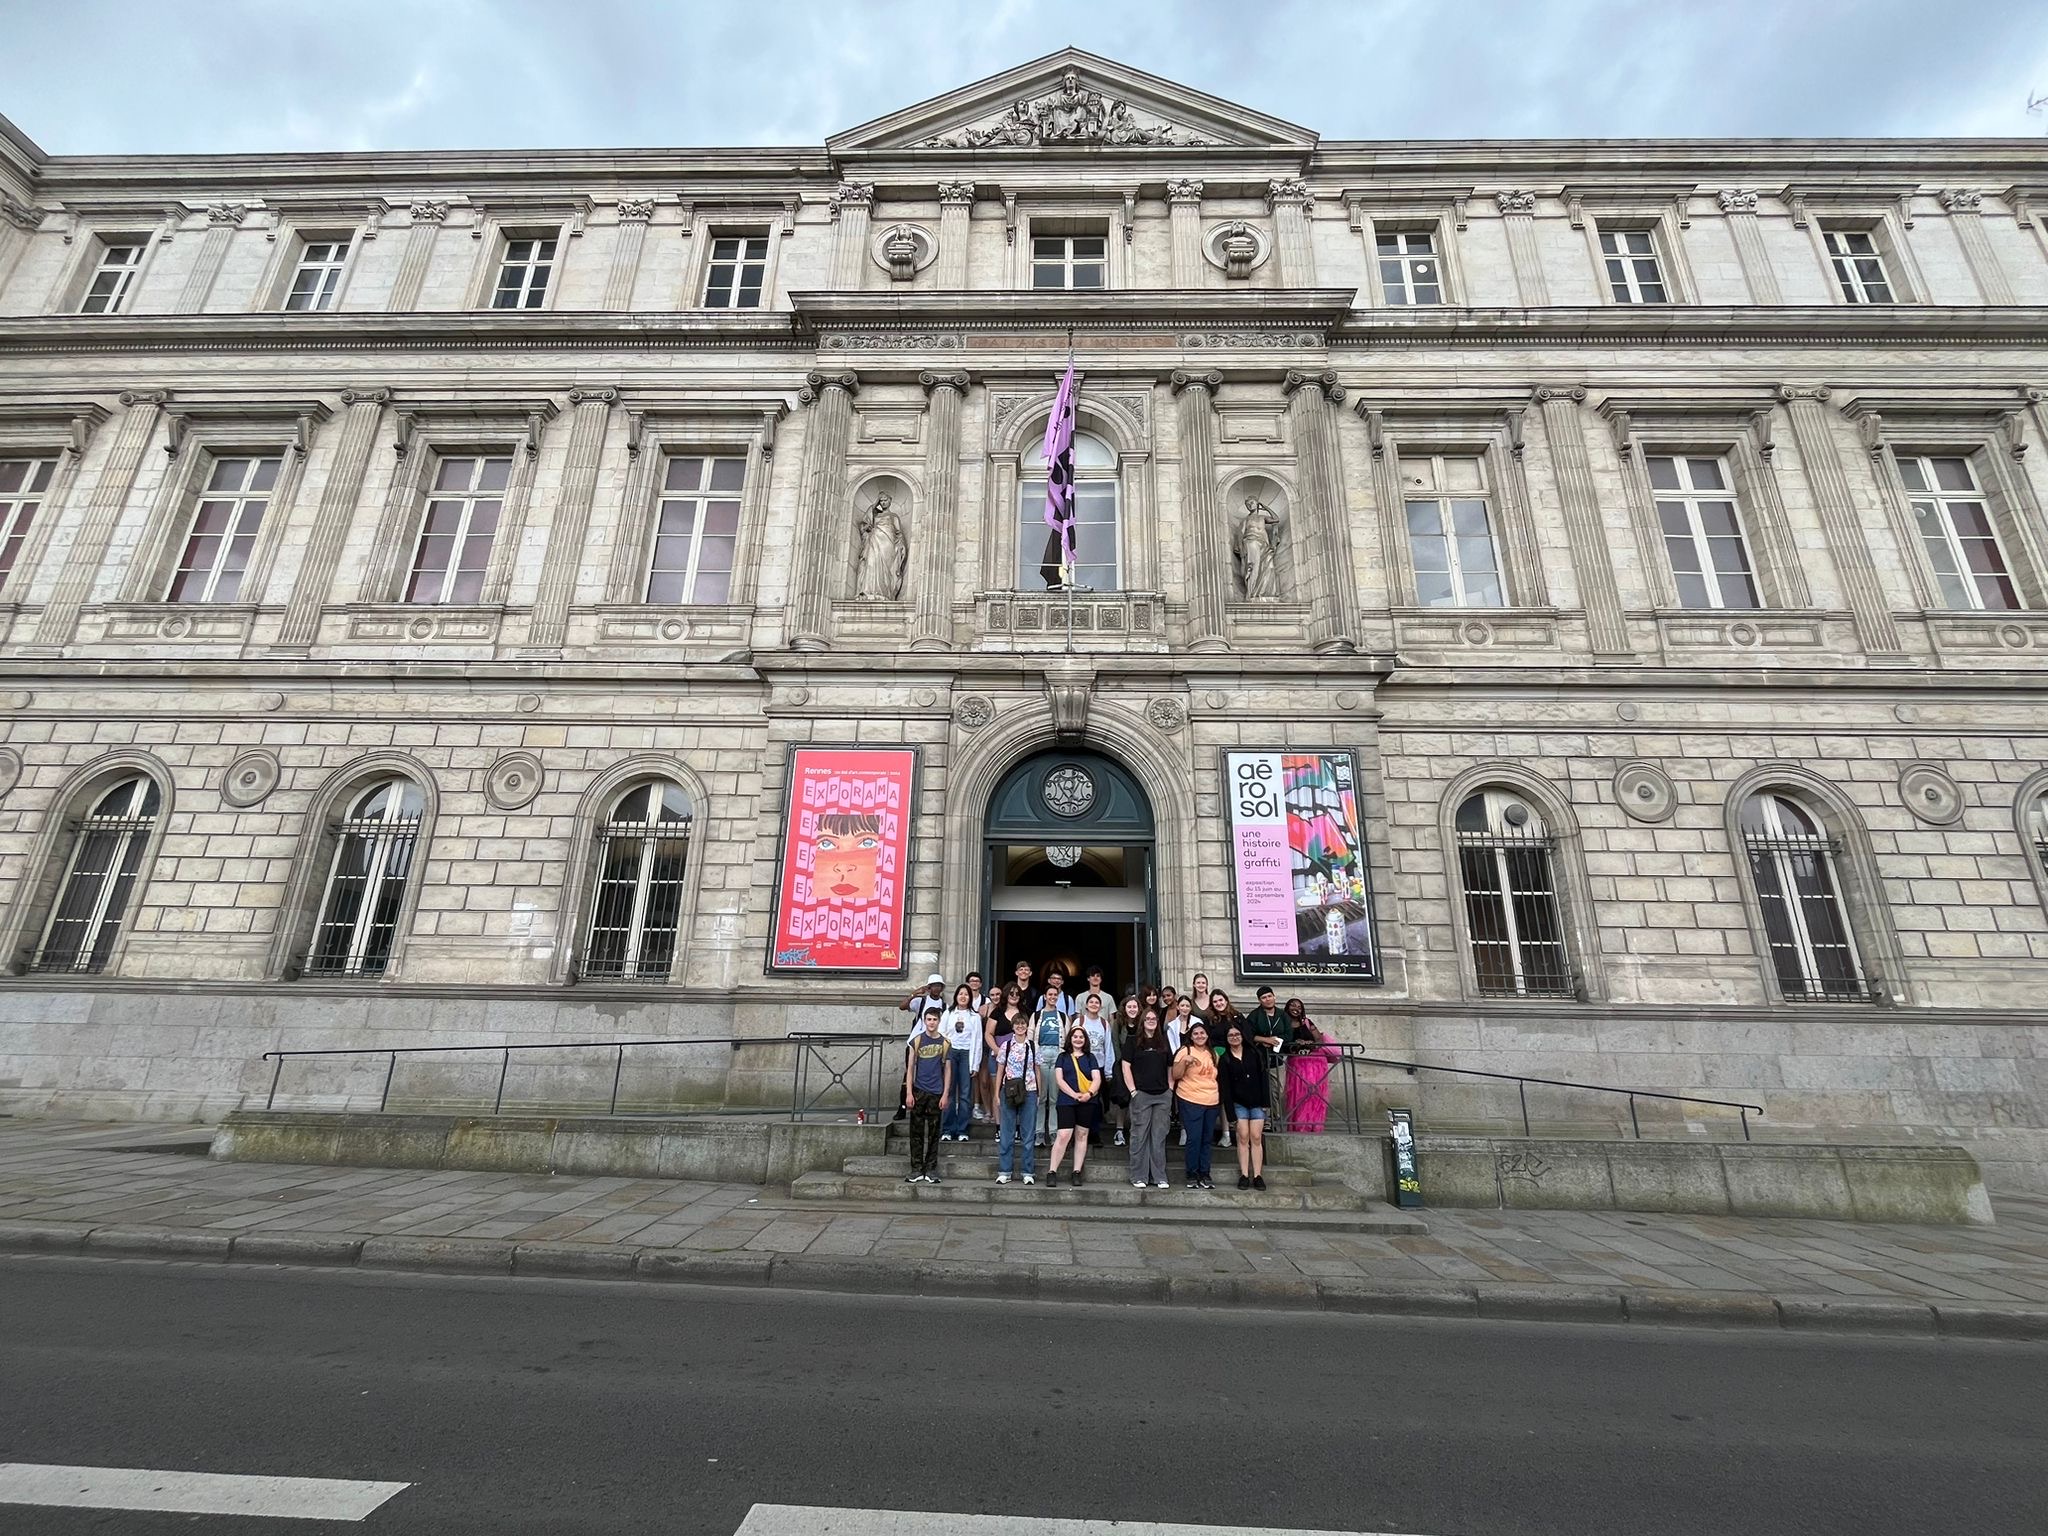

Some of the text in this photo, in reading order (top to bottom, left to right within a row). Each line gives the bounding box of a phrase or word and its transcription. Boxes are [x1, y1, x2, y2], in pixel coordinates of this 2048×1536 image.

[804, 767, 832, 775] Rennes
[805, 784, 898, 801] EXPORAMA
[1239, 782, 1266, 799] ro
[1240, 793, 1279, 818] sol
[1242, 839, 1281, 848] histoire
[1243, 848, 1257, 857] du
[1243, 857, 1281, 869] graffiti
[792, 914, 889, 933] EXPORAMA
